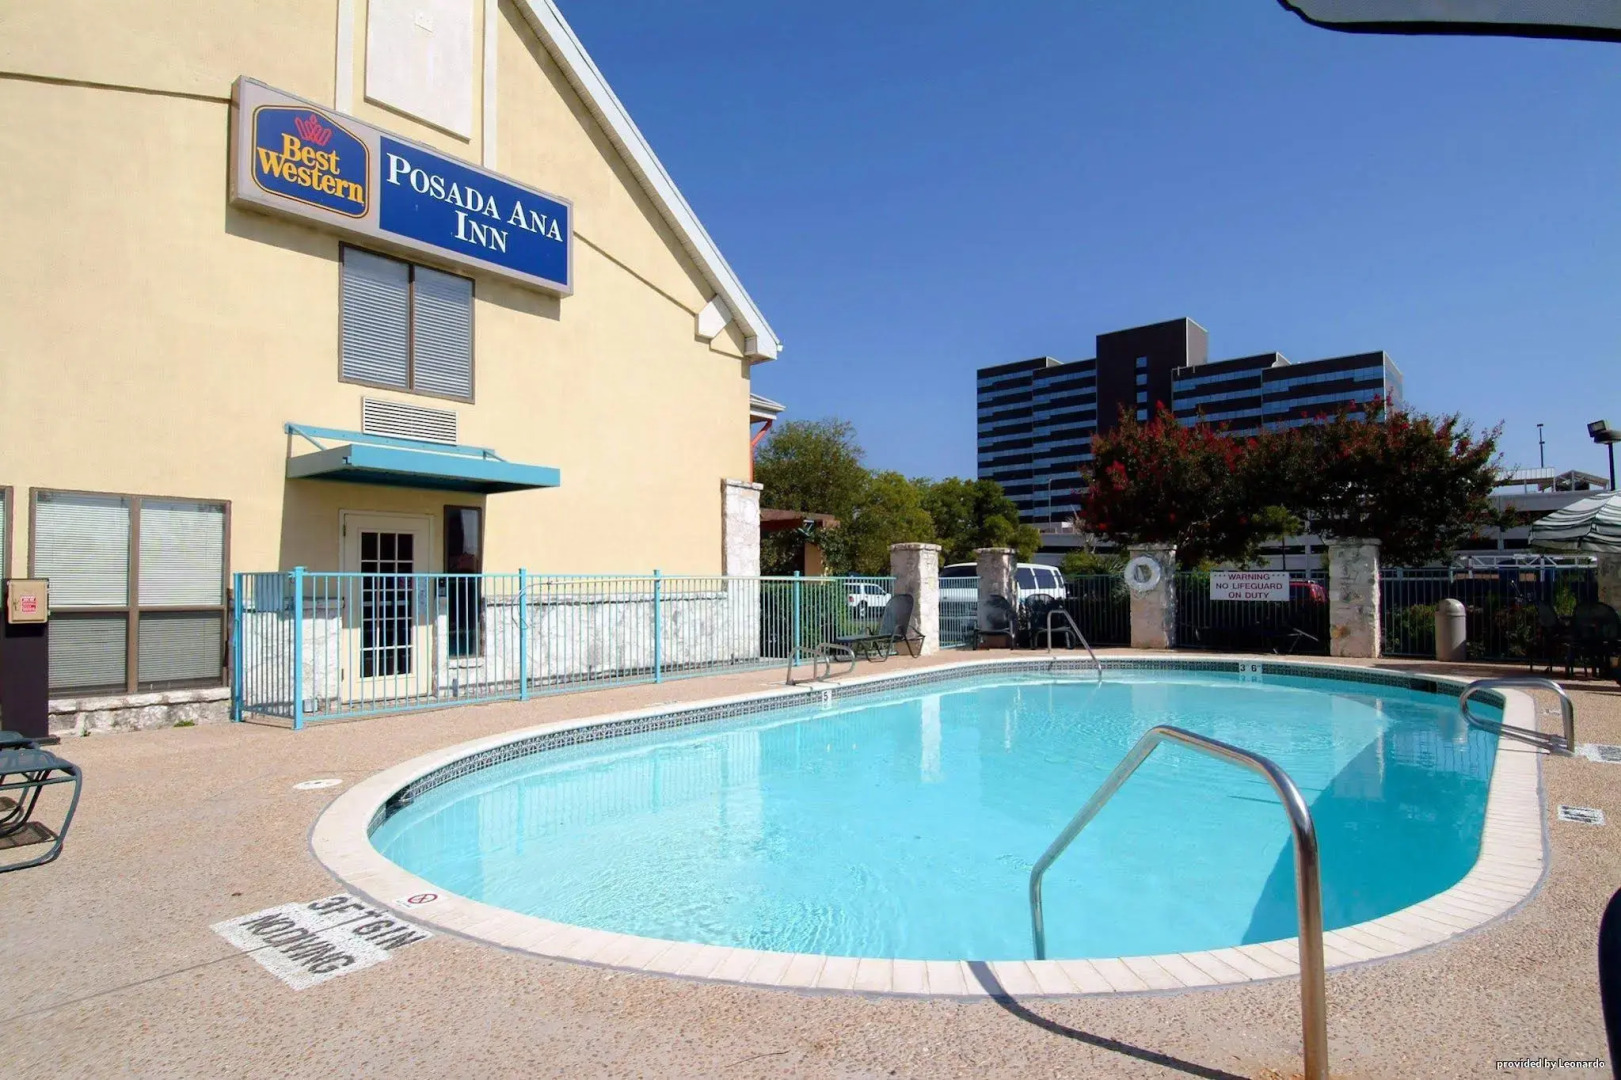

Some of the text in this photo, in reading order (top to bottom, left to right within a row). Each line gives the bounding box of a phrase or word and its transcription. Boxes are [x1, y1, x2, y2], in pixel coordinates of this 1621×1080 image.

[257, 146, 364, 204] Western
[281, 132, 340, 175] Best
[386, 152, 563, 242] POSADA ANA
[454, 210, 508, 253] INN
[1215, 582, 1283, 590] NO LIFEGUARD
[1228, 591, 1242, 599] ON
